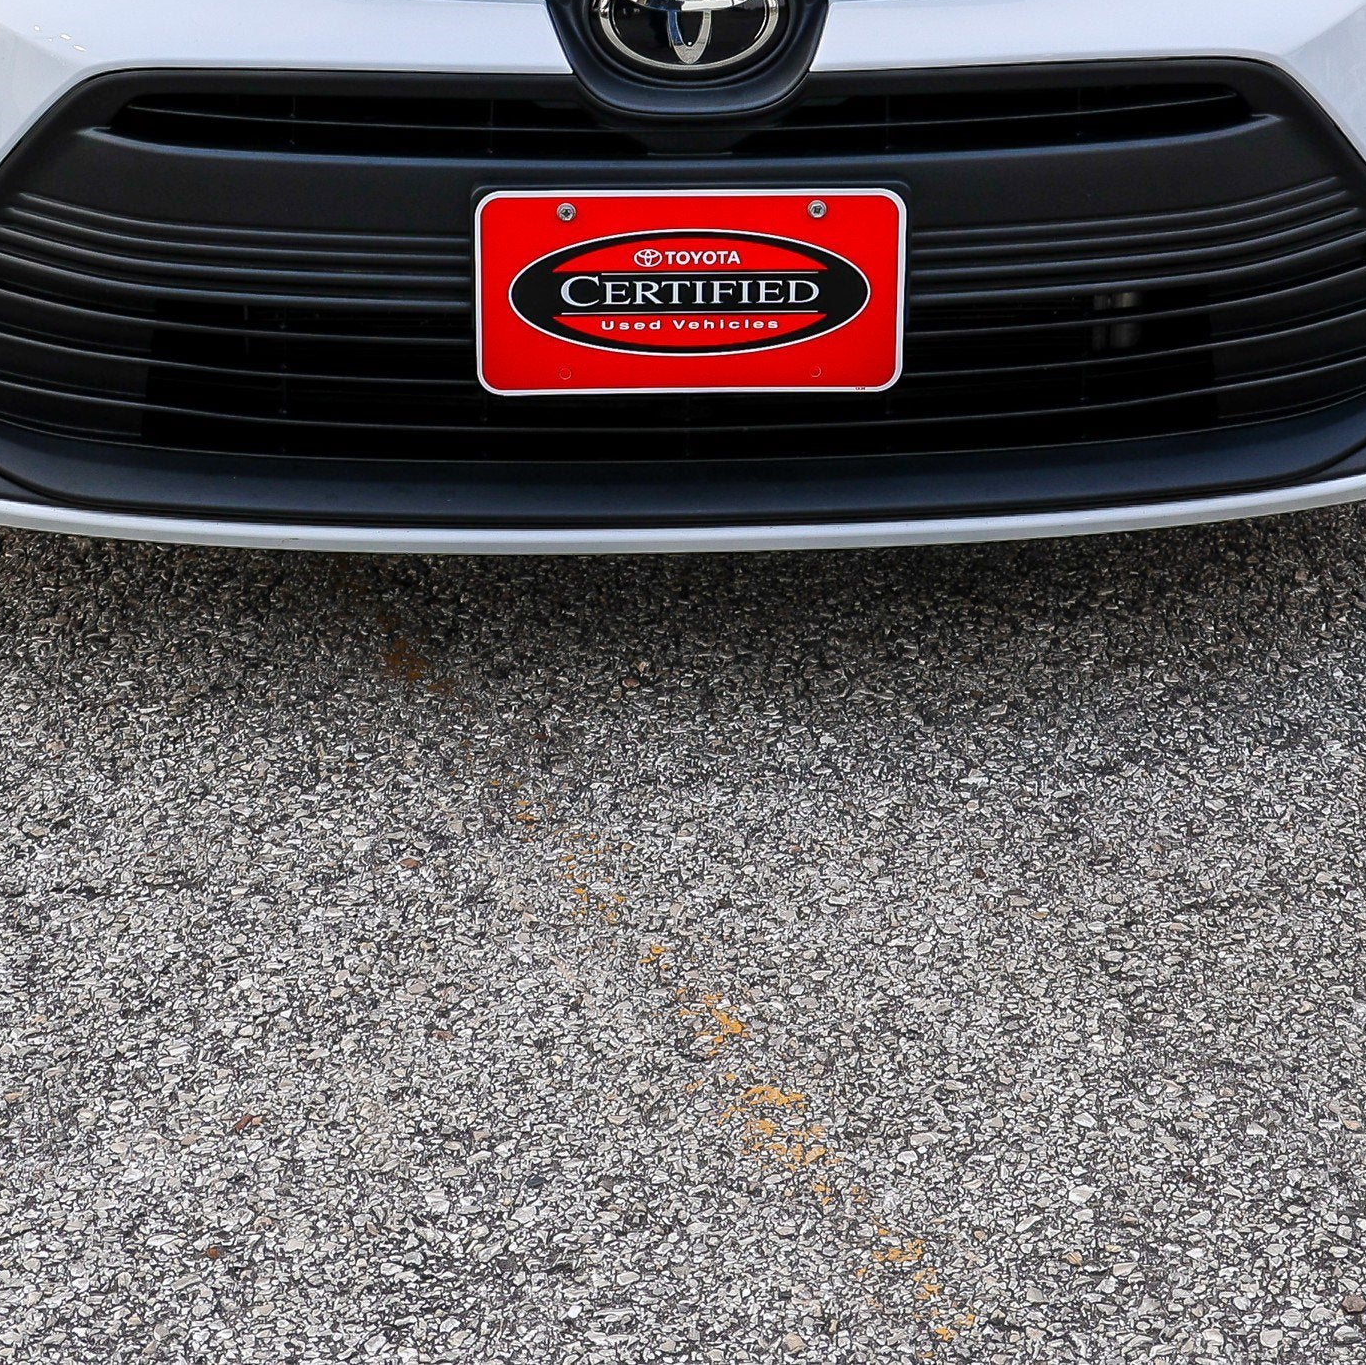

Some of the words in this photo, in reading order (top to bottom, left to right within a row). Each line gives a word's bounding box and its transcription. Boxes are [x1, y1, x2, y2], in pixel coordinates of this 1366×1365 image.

[665, 250, 741, 266] TOYOTA
[560, 275, 820, 307] CERTIFIED
[601, 319, 661, 331] Used
[673, 318, 779, 330] Vehicles
